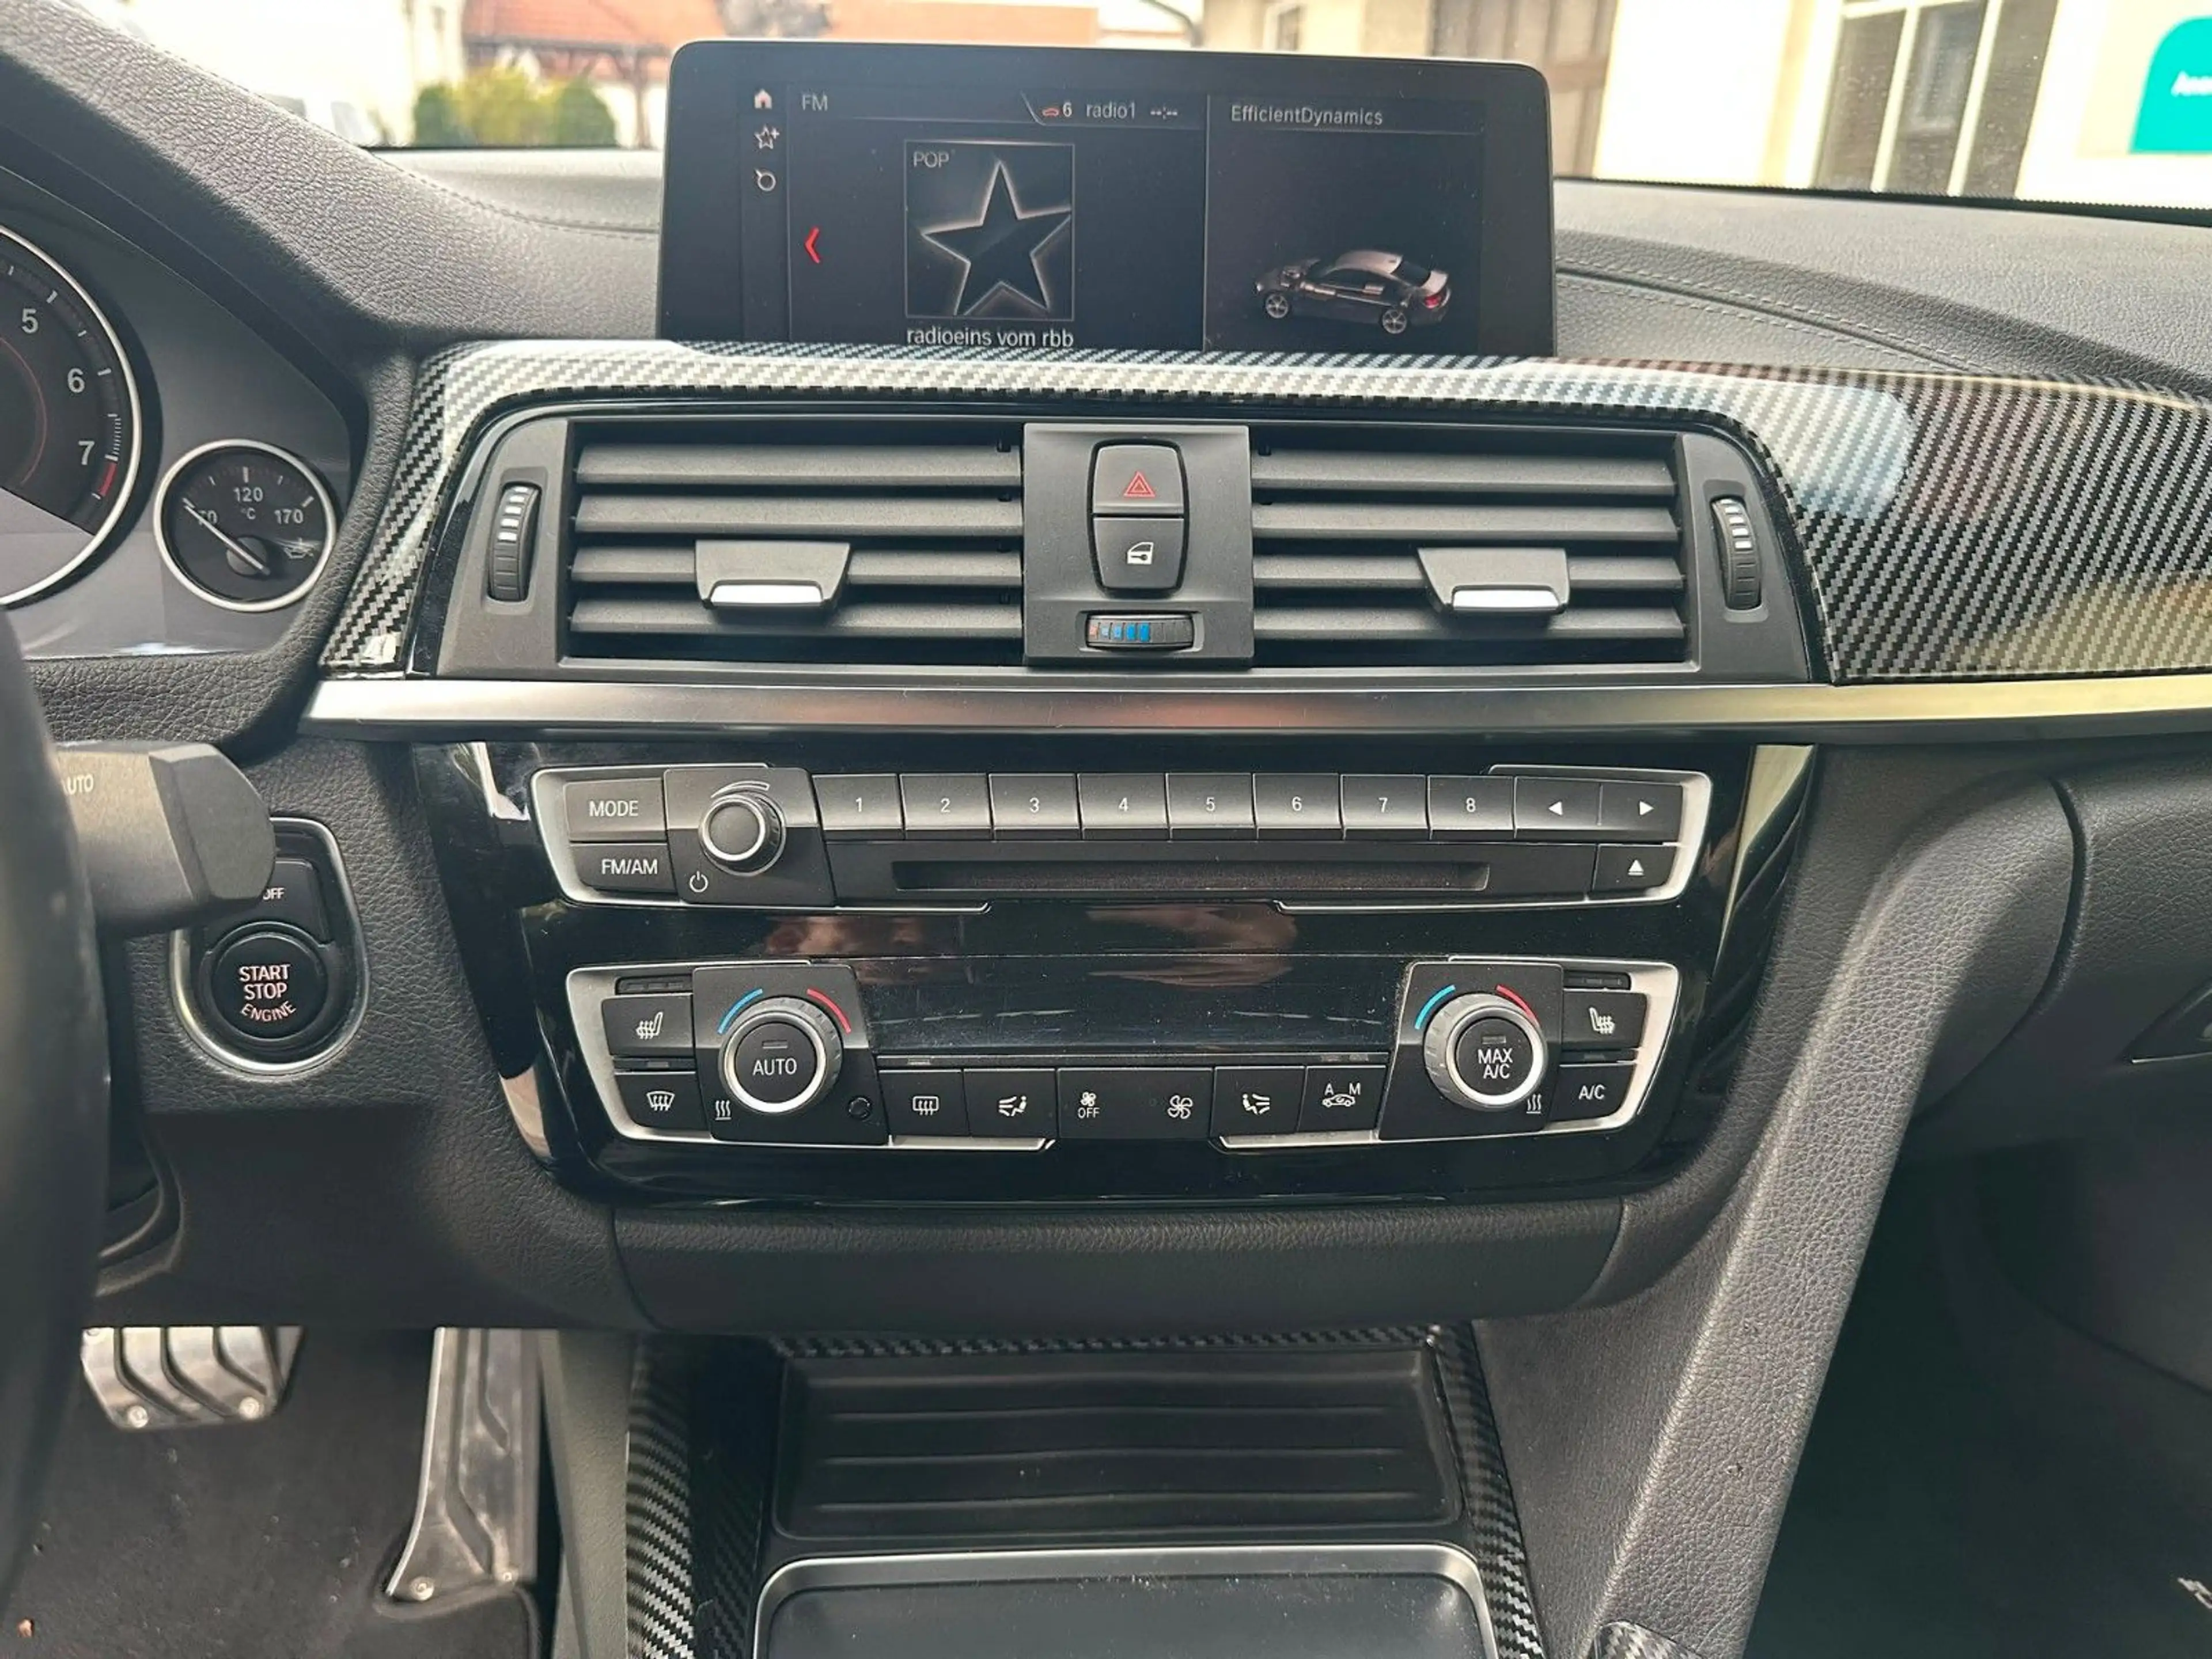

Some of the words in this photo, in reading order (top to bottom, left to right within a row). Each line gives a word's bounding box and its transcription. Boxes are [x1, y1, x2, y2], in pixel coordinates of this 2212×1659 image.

[802, 94, 828, 111] FM
[1086, 101, 1135, 119] radio1
[1231, 105, 1383, 127] EfficientDynamics
[913, 151, 950, 168] POP
[21, 308, 39, 334] 5
[907, 327, 992, 346] radioeins
[997, 331, 1036, 347] vom
[1042, 329, 1075, 347] rbb
[67, 368, 85, 393] 6
[78, 440, 96, 466] 7
[233, 486, 264, 502] 120
[274, 508, 304, 524] 170
[589, 800, 639, 817] MODE
[855, 797, 863, 813] 1
[940, 798, 950, 813] 2
[1029, 797, 1040, 813] 3
[1118, 797, 1129, 813] 4
[1205, 797, 1215, 812] 5
[1291, 796, 1302, 812] 6
[1378, 797, 1388, 814] 7
[1465, 797, 1476, 813] 8
[601, 858, 658, 875] FM/AM
[238, 964, 290, 982] START
[243, 982, 287, 1000] STOP
[240, 1000, 297, 1022] ENGINE
[1477, 1047, 1513, 1065] MAX
[752, 1057, 798, 1076] AUTO
[1483, 1062, 1510, 1080] A/C
[1324, 1082, 1335, 1096] A
[1349, 1082, 1361, 1096] M
[1578, 1084, 1605, 1100] A/C
[1077, 1106, 1100, 1119] OFF
